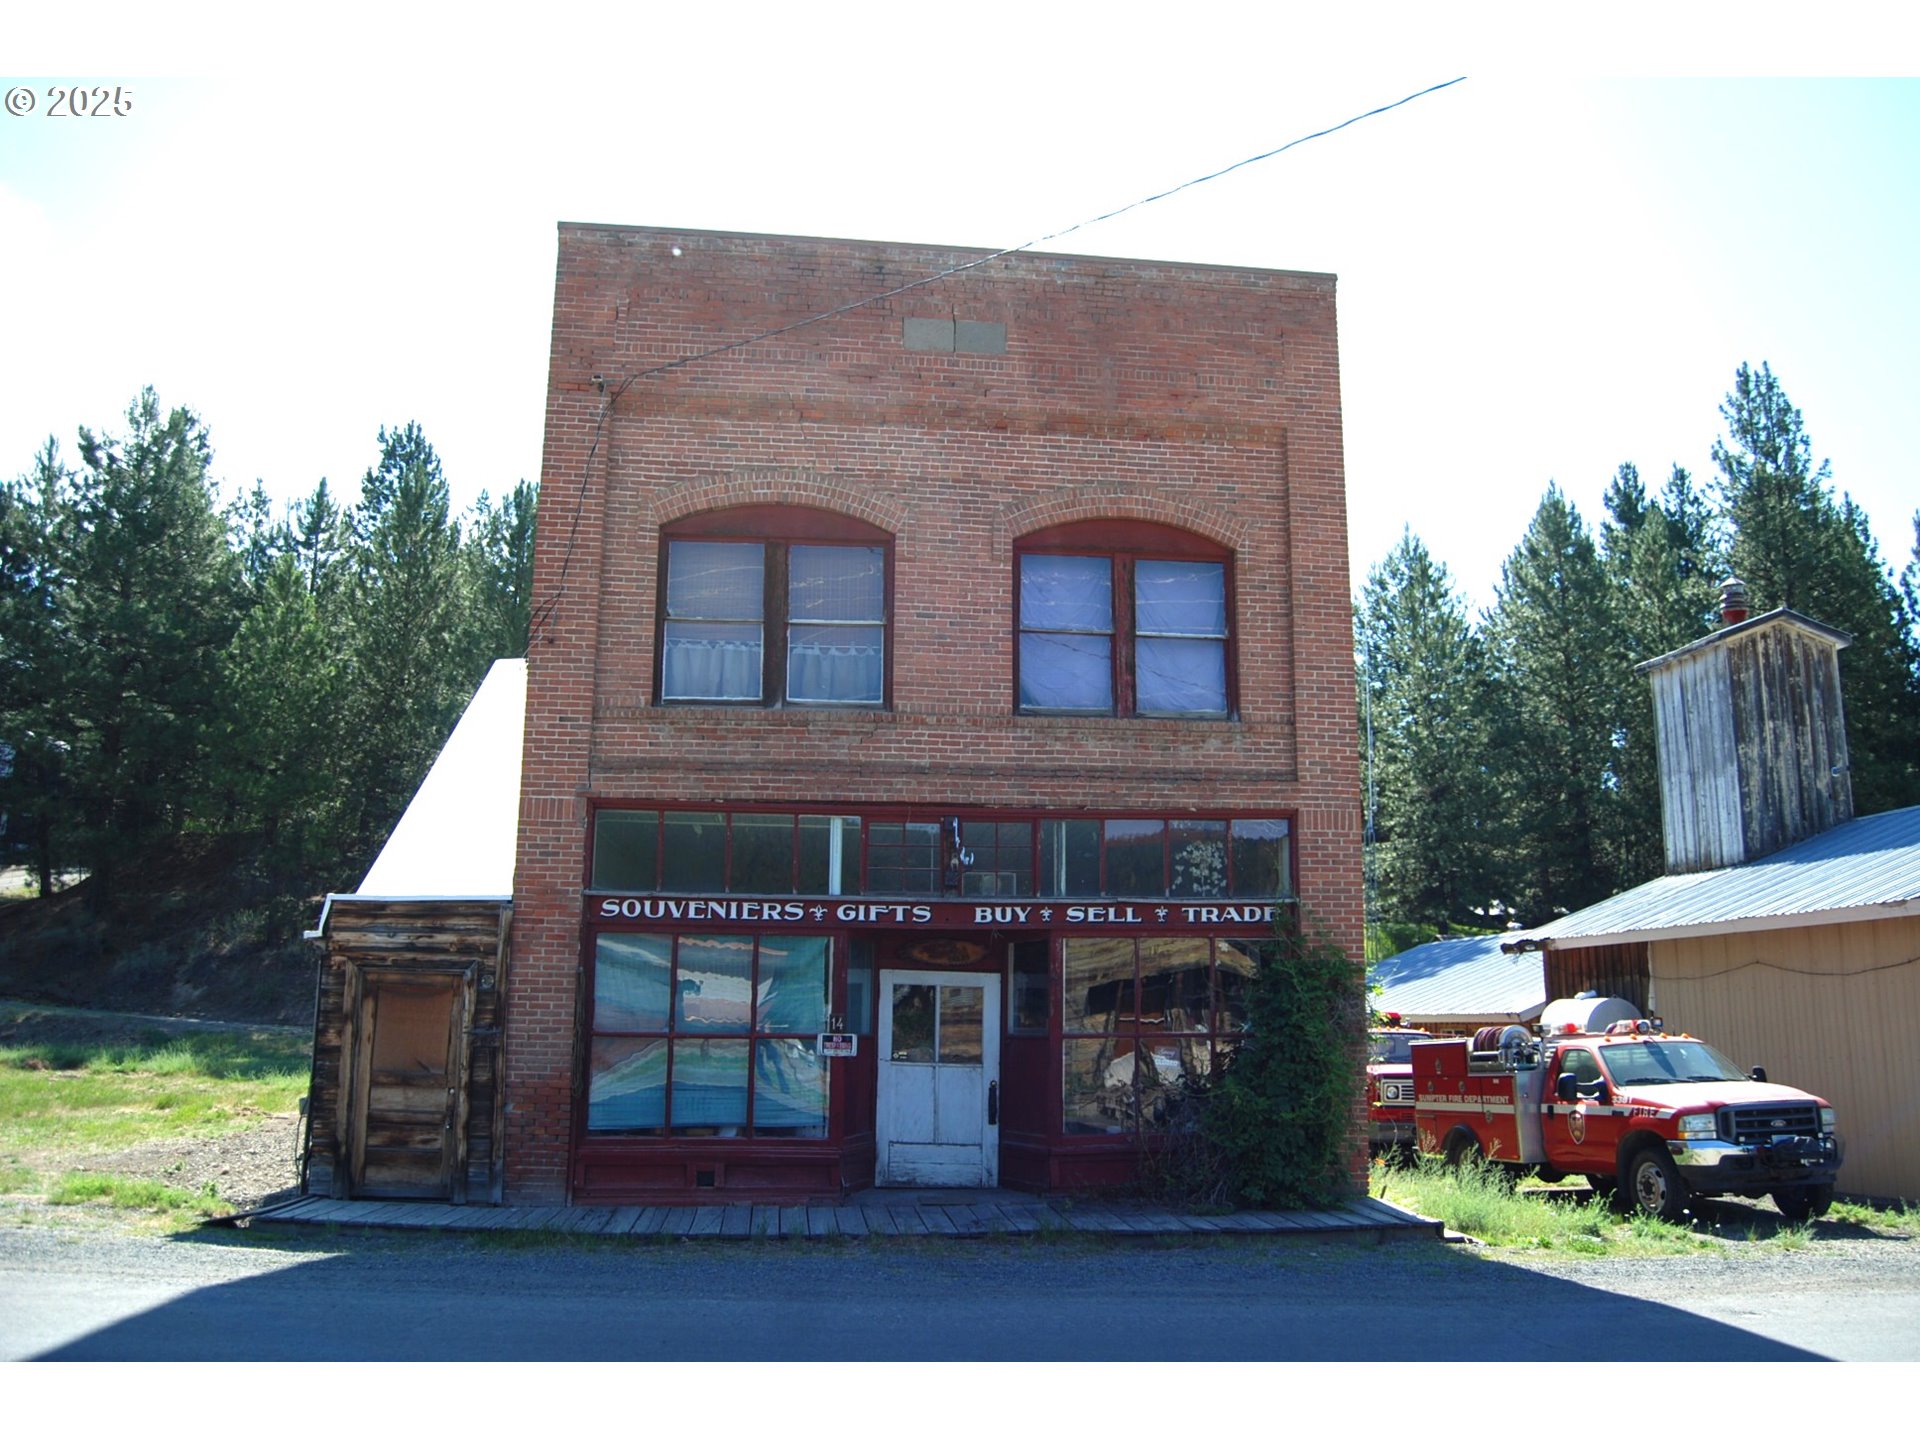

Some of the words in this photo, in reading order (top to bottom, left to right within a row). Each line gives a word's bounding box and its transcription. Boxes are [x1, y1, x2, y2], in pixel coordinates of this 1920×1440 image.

[600, 898, 805, 921] SOUVENIERS
[836, 904, 932, 923] GIFTS
[973, 906, 1032, 924] BUY
[1065, 906, 1142, 923] SELL
[831, 1017, 844, 1030] 14
[1418, 1094, 1447, 1103] SUMPTER
[1448, 1094, 1463, 1103] FIRE
[1464, 1095, 1510, 1104] DEPARTMENT
[1632, 1107, 1656, 1118] FIRE
